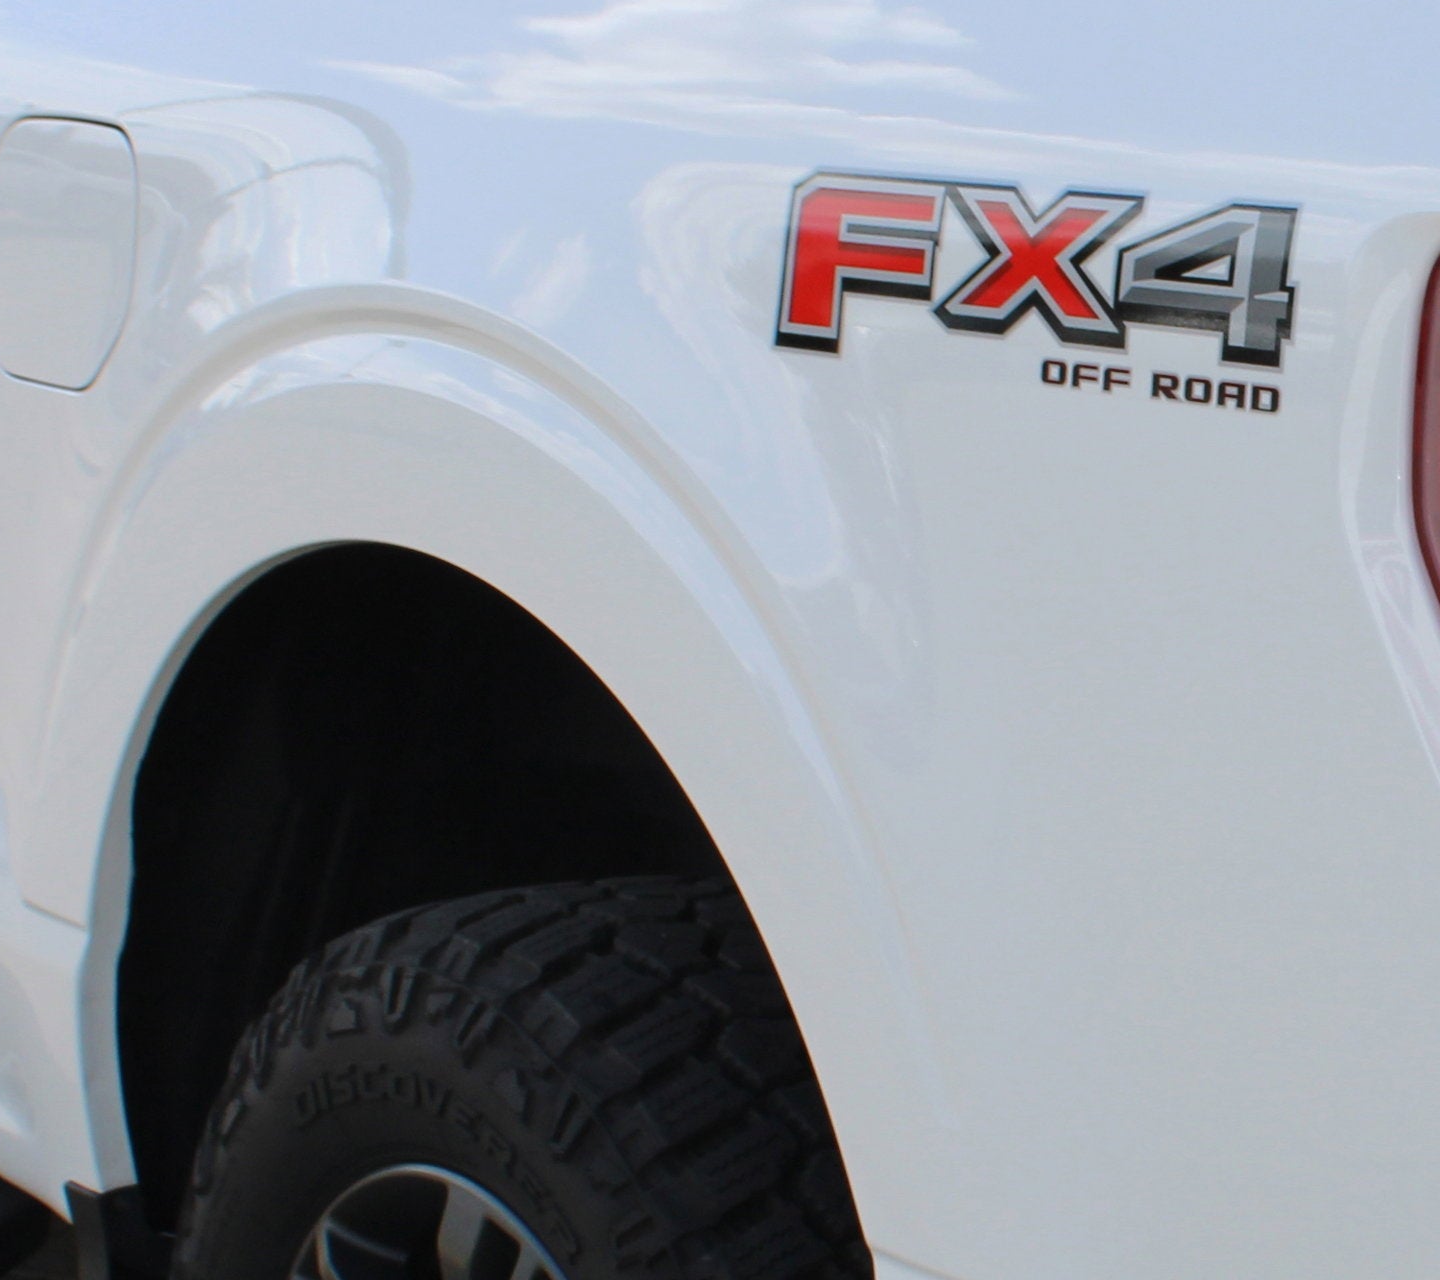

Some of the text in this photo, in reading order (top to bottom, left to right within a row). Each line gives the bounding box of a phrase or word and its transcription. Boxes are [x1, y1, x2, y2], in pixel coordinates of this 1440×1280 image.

[773, 168, 1302, 370] FX4
[1040, 358, 1282, 414] OFF ROAD
[292, 1062, 582, 1266] DISCOVERER
